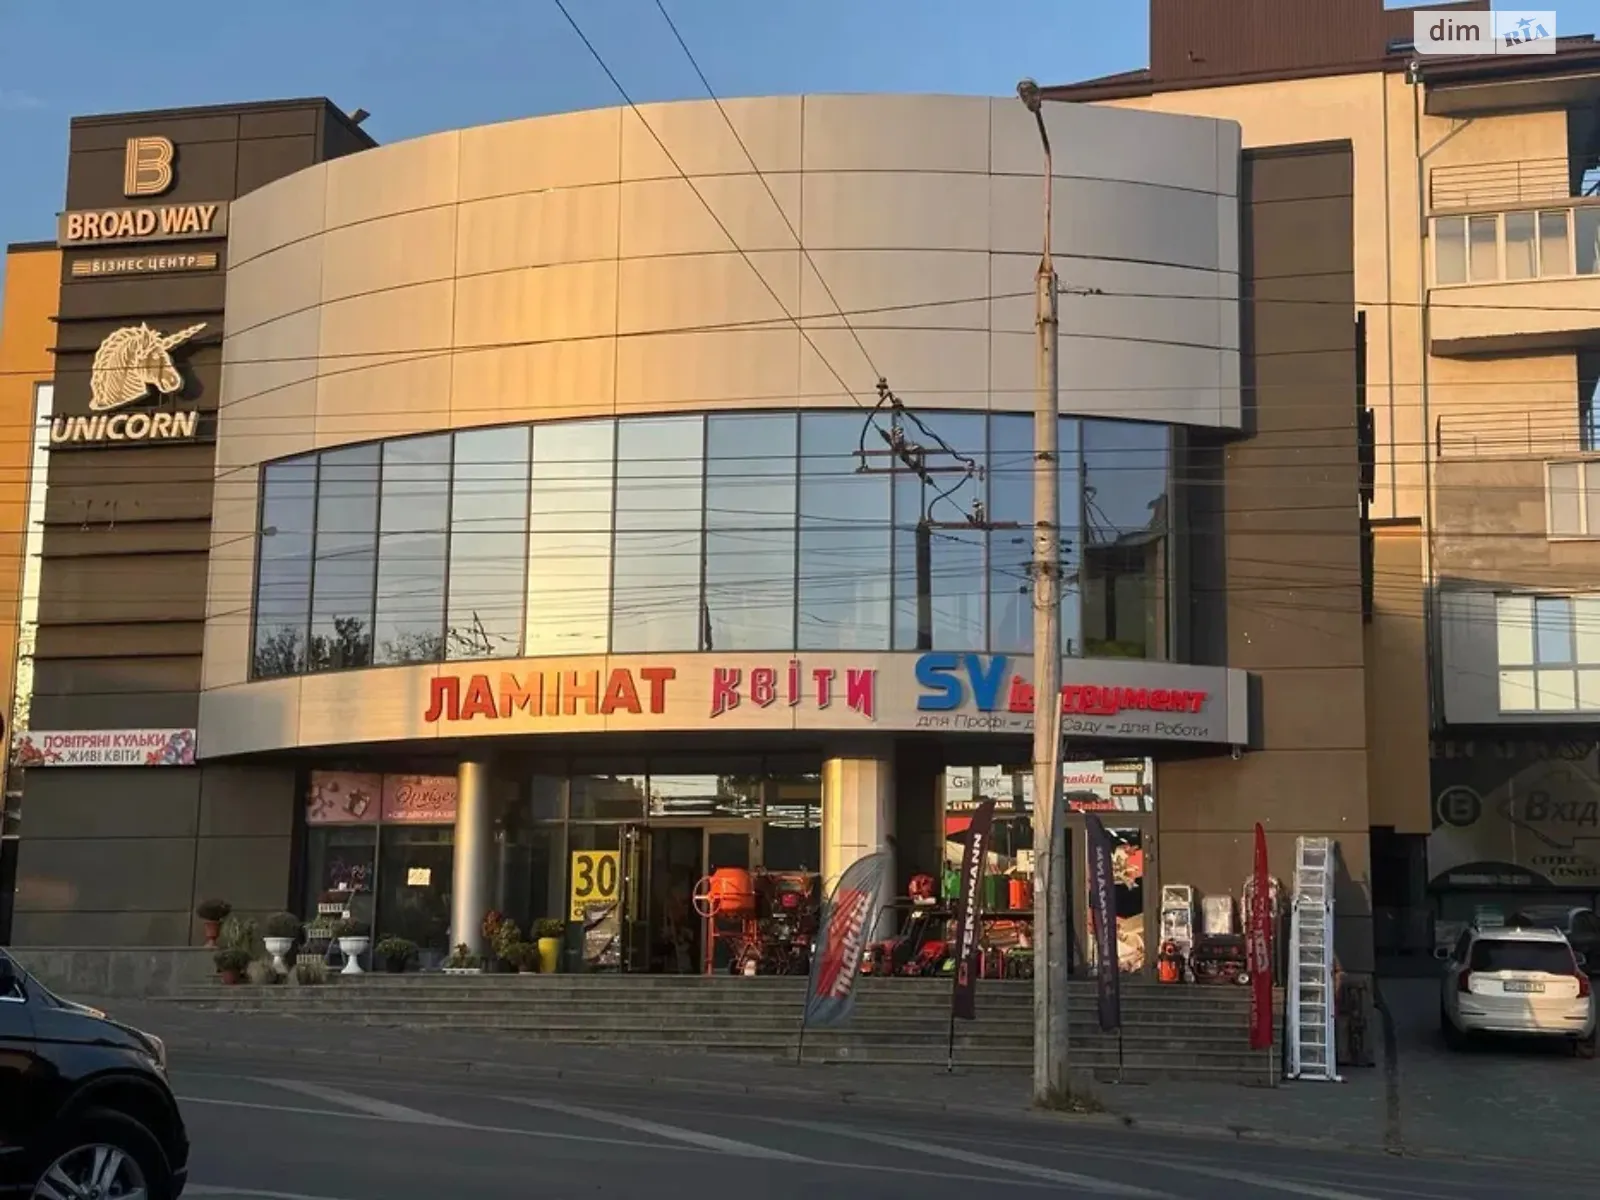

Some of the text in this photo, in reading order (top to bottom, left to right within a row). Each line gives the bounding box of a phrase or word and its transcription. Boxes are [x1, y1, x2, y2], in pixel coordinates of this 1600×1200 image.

[124, 136, 174, 196] B
[67, 205, 217, 240] BROAD WAY
[92, 256, 196, 273] БІЗНЕС ЦЕНТР
[50, 411, 198, 442] UNICORN
[424, 667, 676, 722] ЛАМІНАТ
[914, 652, 1008, 712] SV
[44, 733, 166, 749] ПОВІТРЯНІ КУЛЬКИ
[1118, 722, 1150, 734] для
[1155, 721, 1208, 736] Роботи
[66, 750, 140, 762] ЖИВІ КВІТИ
[575, 855, 616, 897] 30
[961, 834, 982, 957] TEKHMANN
